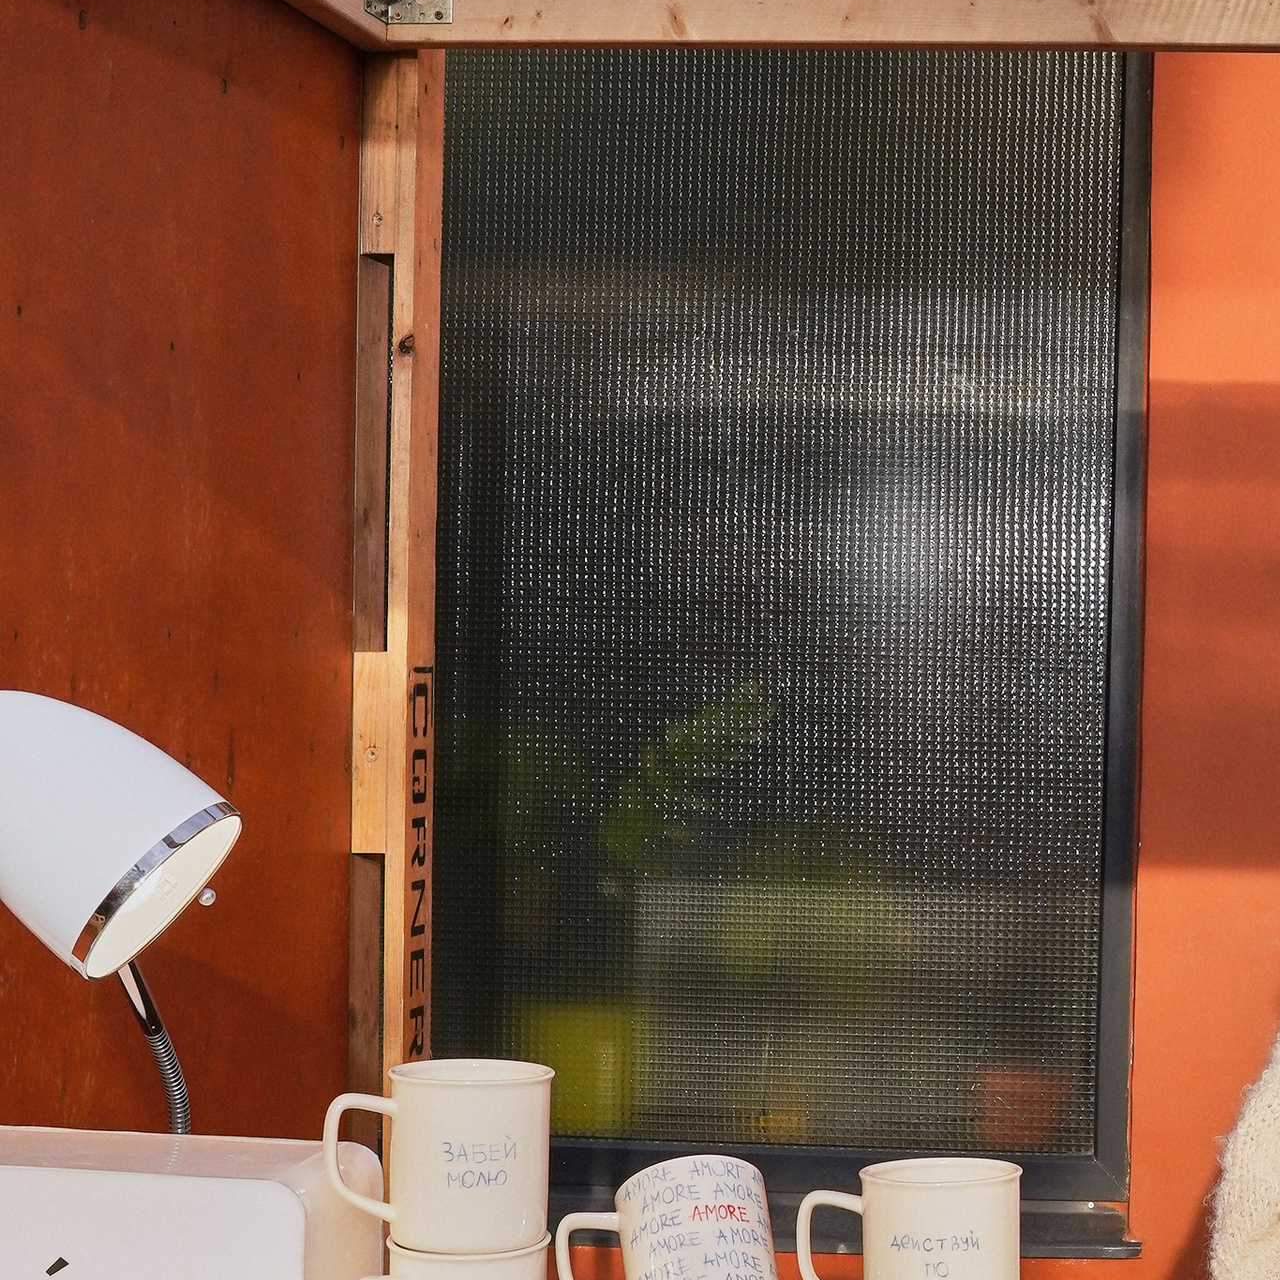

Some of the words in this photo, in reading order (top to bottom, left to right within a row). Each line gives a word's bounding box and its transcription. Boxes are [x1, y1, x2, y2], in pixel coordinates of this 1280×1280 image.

[411, 682, 430, 1058] CORNER
[442, 1135, 517, 1164] ЗАБЕЙ
[447, 1170, 508, 1189] МОЛЮ
[642, 1184, 701, 1215] AMORE
[713, 1182, 763, 1210] AMORE
[630, 1209, 682, 1250] AMORE
[690, 1204, 750, 1223] AMORE
[649, 1231, 702, 1261] AMORE
[716, 1227, 771, 1256] AMORE
[704, 1250, 763, 1275] AMORE
